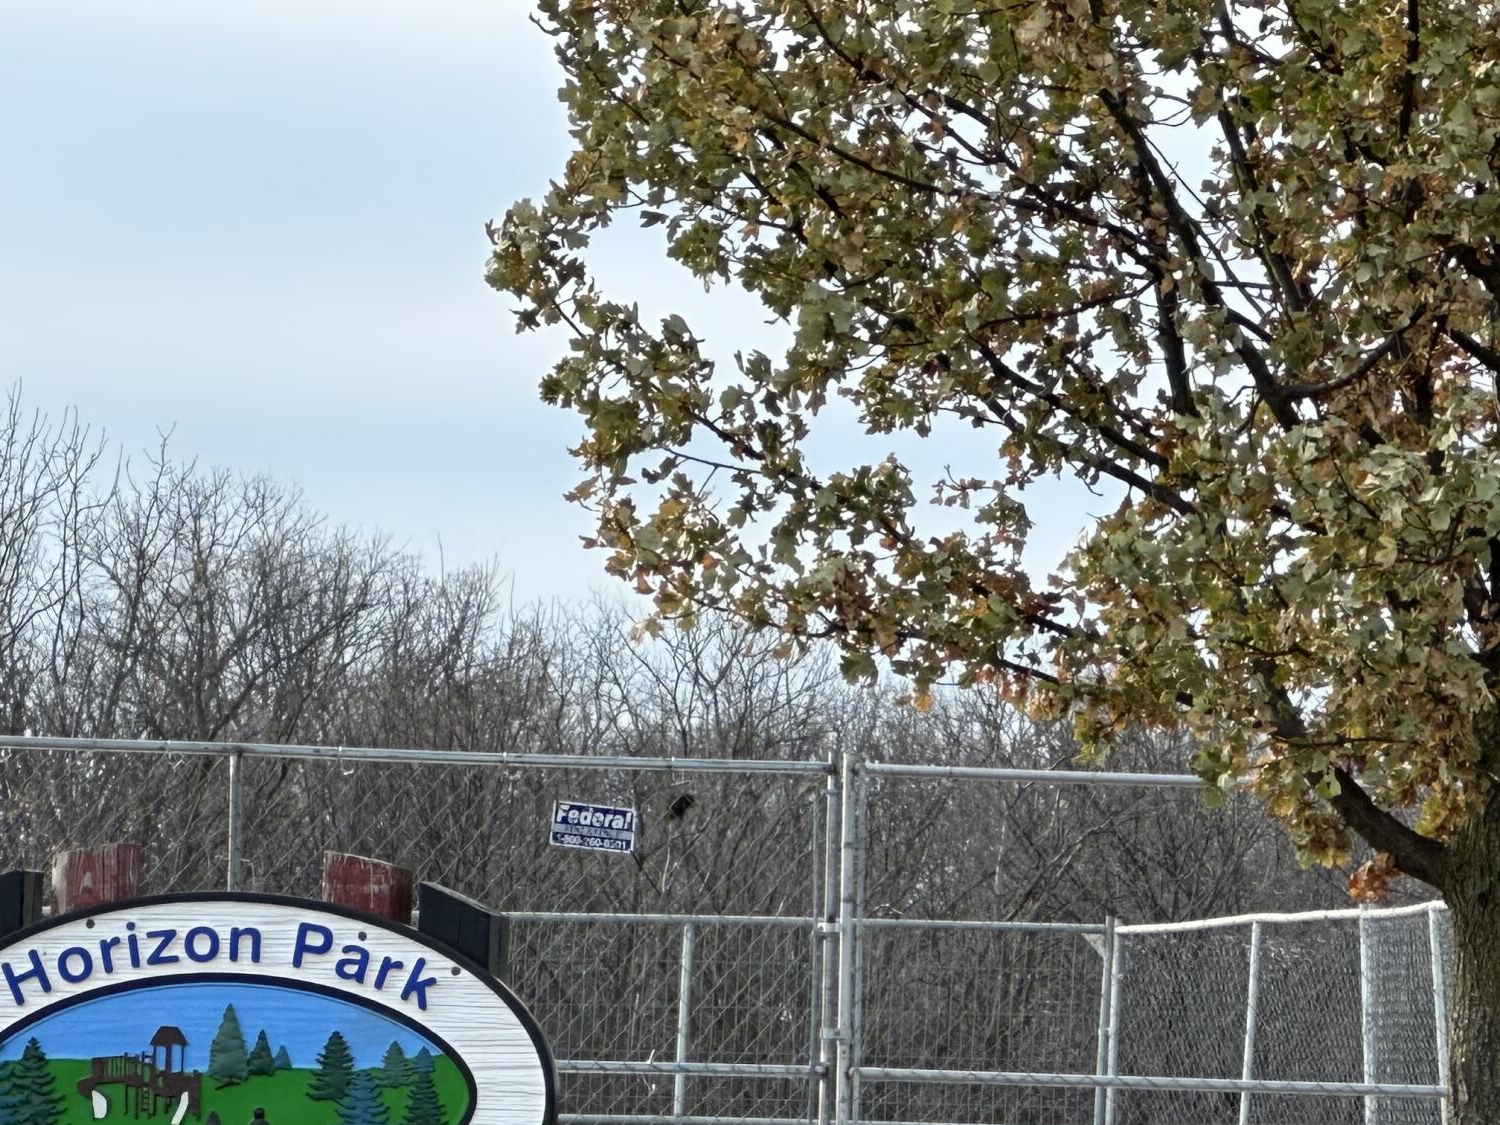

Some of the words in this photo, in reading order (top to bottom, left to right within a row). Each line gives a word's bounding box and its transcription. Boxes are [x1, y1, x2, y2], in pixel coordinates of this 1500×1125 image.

[556, 804, 632, 829] Federal
[3, 922, 261, 1005] Horizon
[293, 923, 437, 1010] Park
